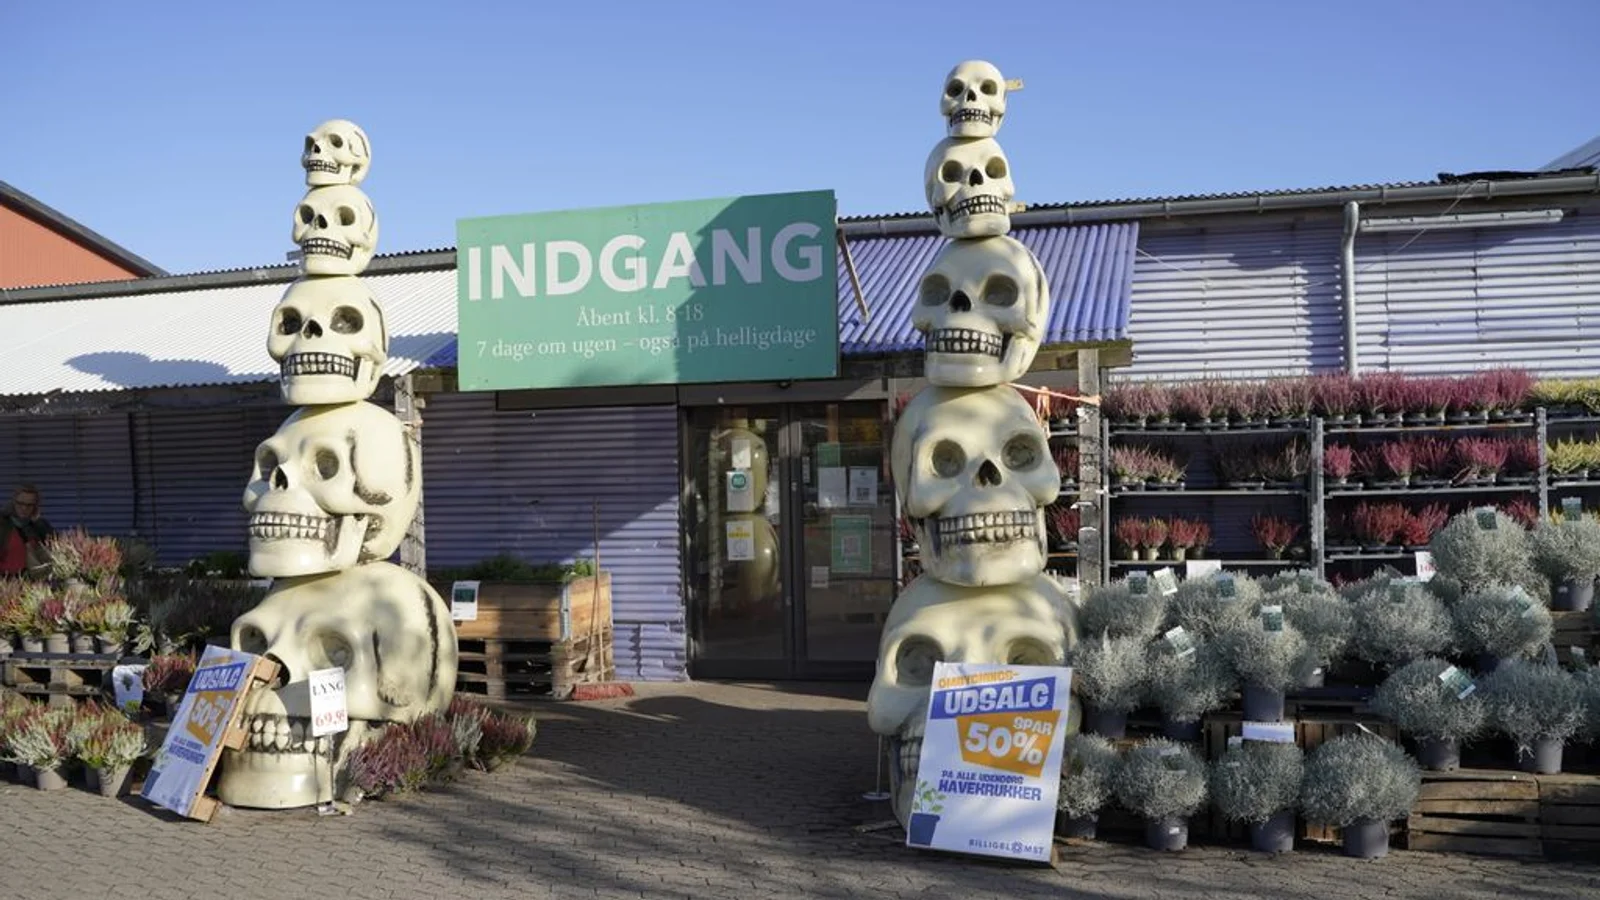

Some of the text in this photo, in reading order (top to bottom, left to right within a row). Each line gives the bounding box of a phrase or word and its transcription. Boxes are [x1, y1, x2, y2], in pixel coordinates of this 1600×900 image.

[468, 222, 824, 301] INDGANG
[577, 304, 704, 326] Åbent kl. 8-18
[477, 341, 487, 358] 7
[492, 339, 533, 362] dage
[538, 342, 567, 355] om
[573, 339, 617, 359] ugen
[639, 331, 681, 356] også
[688, 331, 710, 354] på
[716, 325, 817, 351] helligdage
[195, 665, 242, 690] UDSALG
[313, 681, 344, 697] LYNG
[943, 682, 1050, 715] UDSALG
[1012, 715, 1053, 736] SPAR
[964, 721, 1042, 765] 50%
[956, 771, 976, 781] ALLE
[938, 779, 1042, 802] HAVEKRUKKER
